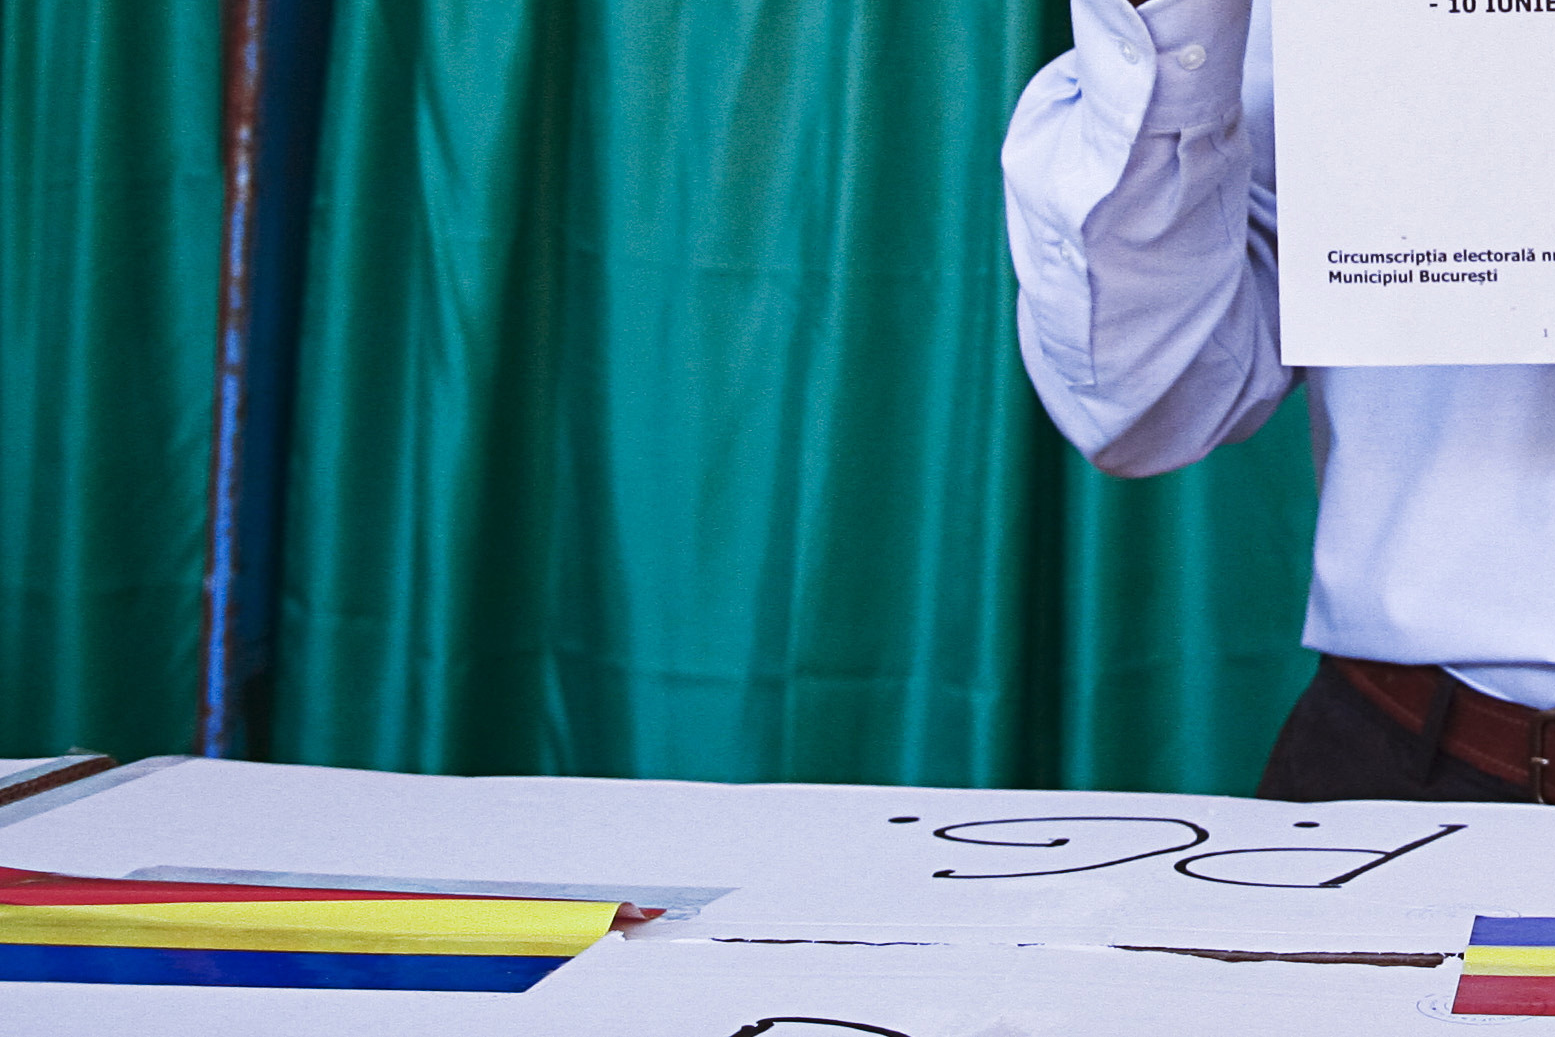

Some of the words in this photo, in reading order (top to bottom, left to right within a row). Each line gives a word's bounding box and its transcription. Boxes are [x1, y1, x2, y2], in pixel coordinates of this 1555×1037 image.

[1327, 249, 1447, 266] Circumscripția
[1453, 248, 1536, 263] electorală
[1329, 270, 1413, 287] Municipiul
[1420, 268, 1498, 285] București
